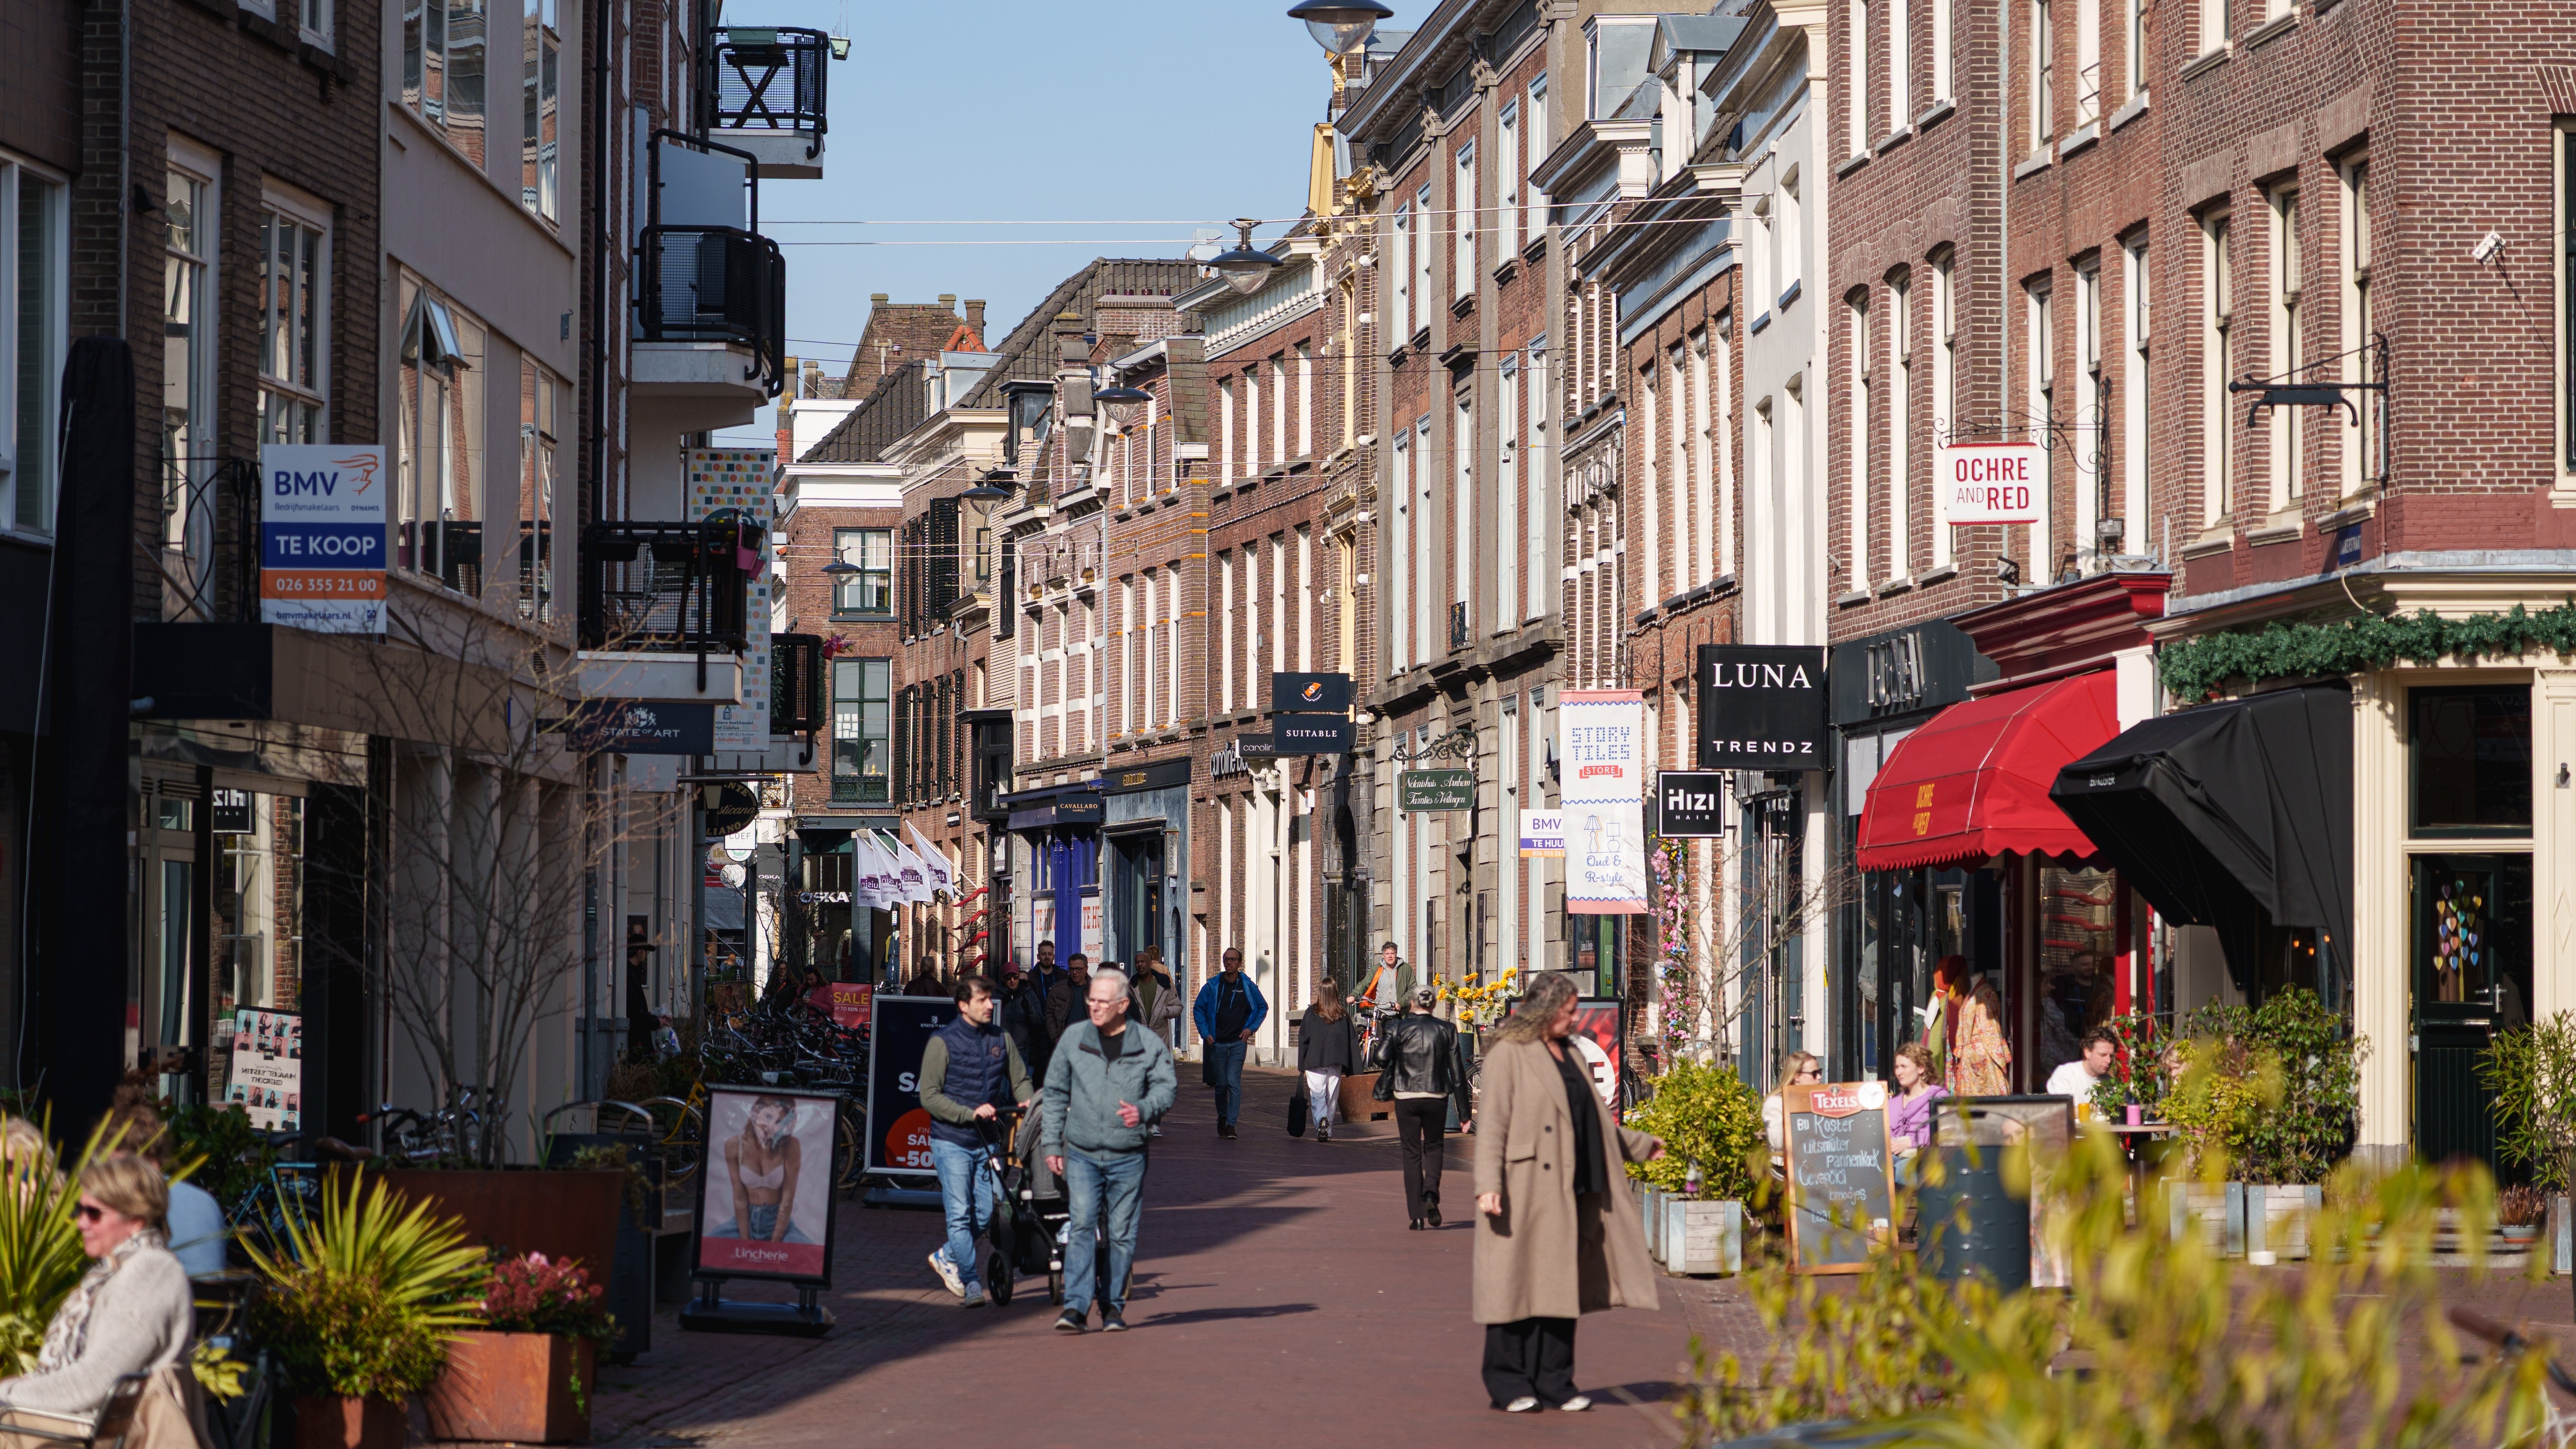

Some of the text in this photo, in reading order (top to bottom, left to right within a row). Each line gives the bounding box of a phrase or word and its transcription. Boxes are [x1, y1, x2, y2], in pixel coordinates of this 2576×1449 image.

[1956, 457, 2029, 482] OCHRE
[274, 471, 338, 496] BMV
[1957, 486, 2030, 510] AND RED
[274, 503, 340, 513] Bedrijfsmakelaars
[275, 536, 376, 555] TE KOOP
[276, 578, 376, 591] 026 355 21 00
[276, 611, 351, 620] bmvmakelaars.nl
[1713, 663, 1812, 688] LUNA
[600, 728, 641, 737] STATE
[1573, 727, 1629, 743] STORY
[1573, 745, 1629, 760] TILES
[1713, 740, 1812, 753] TRENDZ
[1586, 766, 1615, 775] STORE
[1401, 775, 1470, 789] Notarishuis Arnhem
[1406, 792, 1433, 805] Taxaties
[1436, 791, 1466, 807] Veilingen
[1669, 789, 1714, 810] HIZI
[1917, 784, 1935, 809] OCHRE
[1533, 819, 1561, 829] BMV
[1917, 812, 1930, 835] RED
[1587, 855, 1610, 867] Oud
[1585, 871, 1624, 887] R-style
[800, 891, 850, 903] OSKA
[1035, 909, 1042, 931] TE
[1083, 906, 1090, 929] TE
[834, 992, 869, 1004] SALE
[1814, 1115, 1854, 1139] Koster
[735, 1247, 788, 1261] Lincherie
